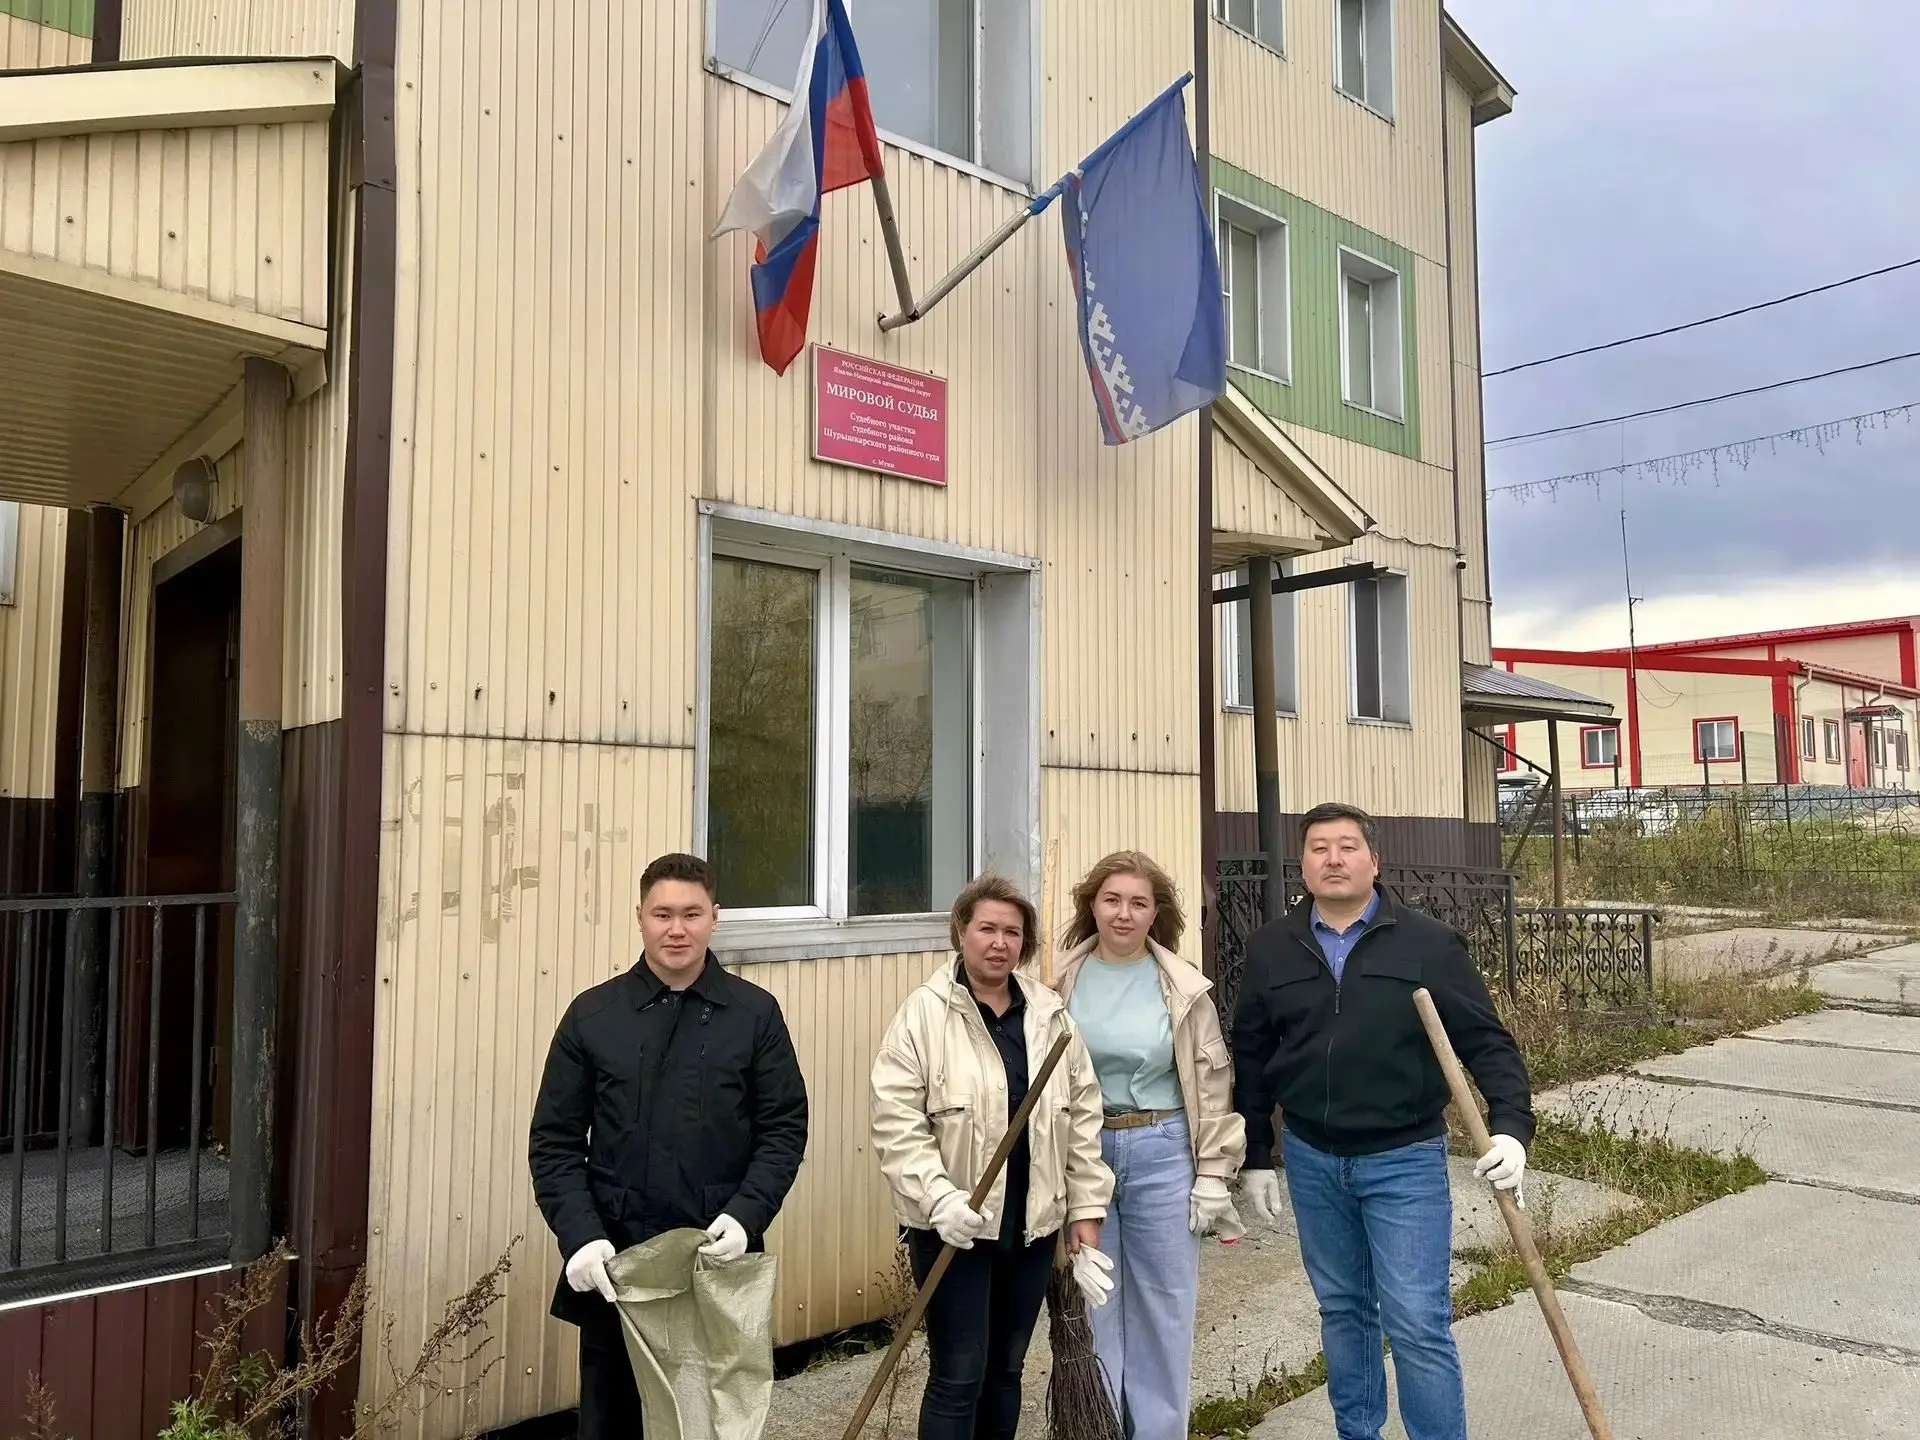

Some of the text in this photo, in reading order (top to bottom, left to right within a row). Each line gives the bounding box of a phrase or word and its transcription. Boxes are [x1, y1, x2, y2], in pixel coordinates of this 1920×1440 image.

[833, 367, 881, 384] Ямало-Ненецкий
[916, 388, 931, 397] округ
[841, 360, 924, 387] РОССИЙСКАЯ ФЕДЕРАЦИЯ
[826, 382, 938, 421] МИРОВОЙ СУДЬЯ
[850, 412, 916, 435] Судебного участка
[852, 425, 913, 445] судебного района
[824, 428, 940, 462] Шурышкарского районного суда
